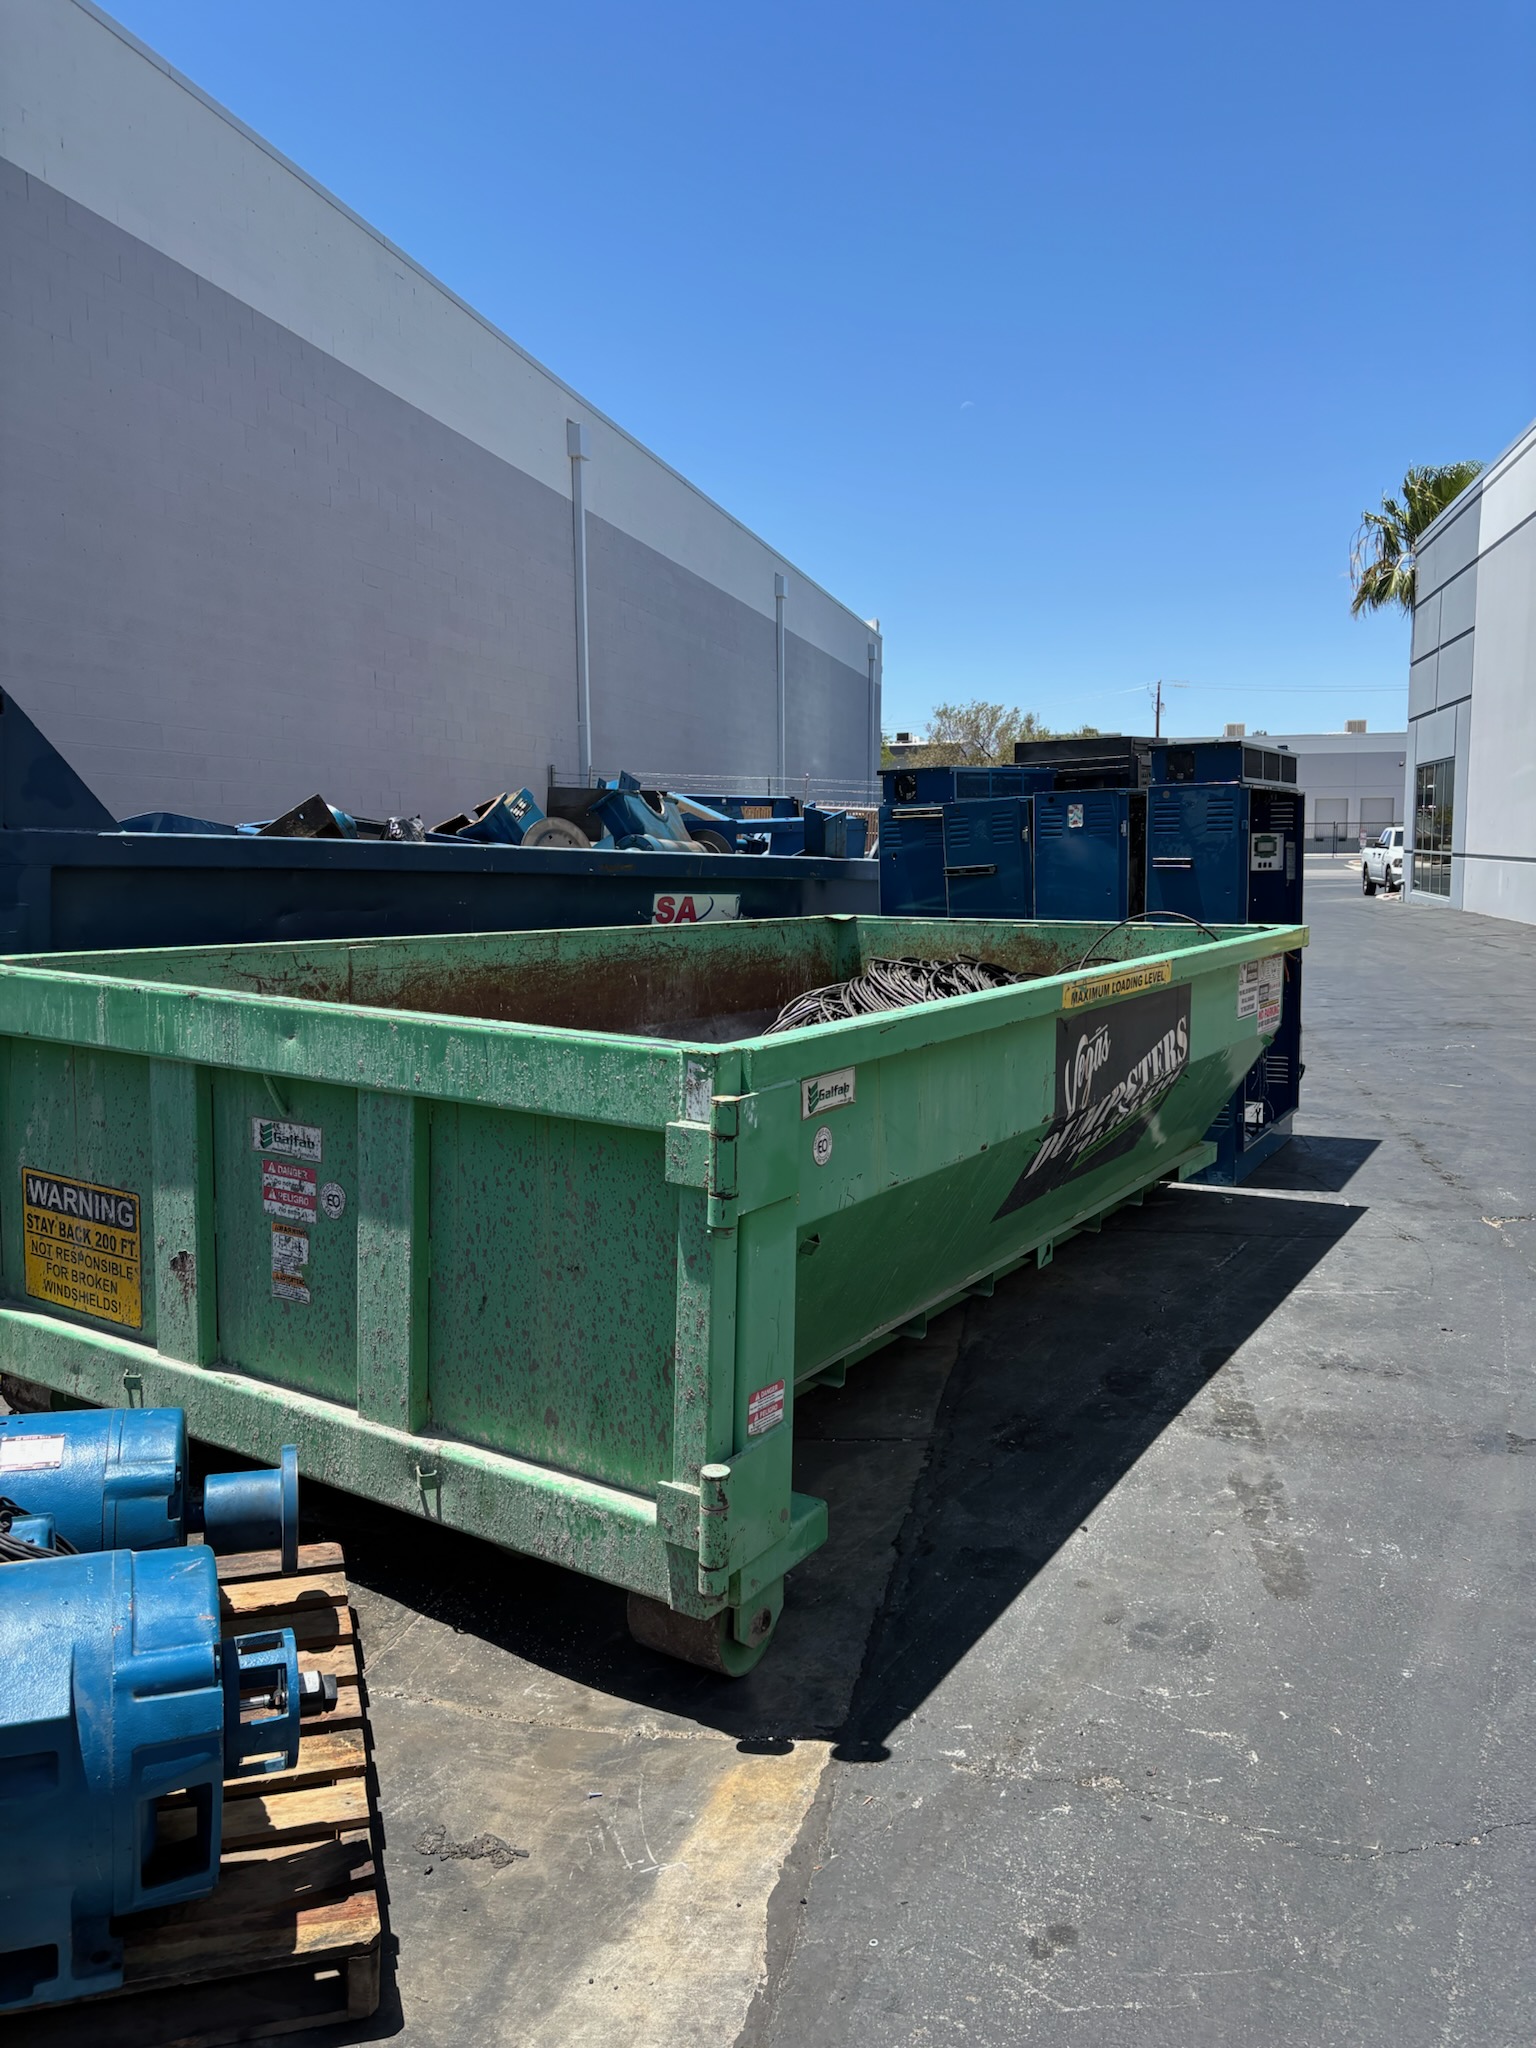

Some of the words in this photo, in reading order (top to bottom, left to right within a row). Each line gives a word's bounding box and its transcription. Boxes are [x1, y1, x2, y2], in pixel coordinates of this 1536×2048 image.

[655, 896, 698, 924] SA
[1071, 983, 1110, 1005] MAXIMUM
[1111, 976, 1143, 994] LOADING
[1144, 971, 1165, 985] LEVEL
[1064, 1024, 1112, 1121] Vegas
[818, 1082, 850, 1101] Galfab
[1024, 1015, 1188, 1180] DUMPSTERS
[277, 1165, 308, 1180] DANGER
[28, 1177, 134, 1228] WARNING
[27, 1213, 56, 1235] STAY
[59, 1221, 92, 1245] BACK
[95, 1231, 117, 1252] 200
[121, 1238, 138, 1258] FT.
[31, 1239, 52, 1256] NOT
[56, 1246, 133, 1280] RESPONSIBLE
[46, 1262, 69, 1280] FOR
[72, 1270, 118, 1295] BROKEN
[44, 1279, 122, 1314] WINDSHIELDS!
[761, 1384, 778, 1396] DANGER
[759, 1404, 778, 1419] PELIGRO
